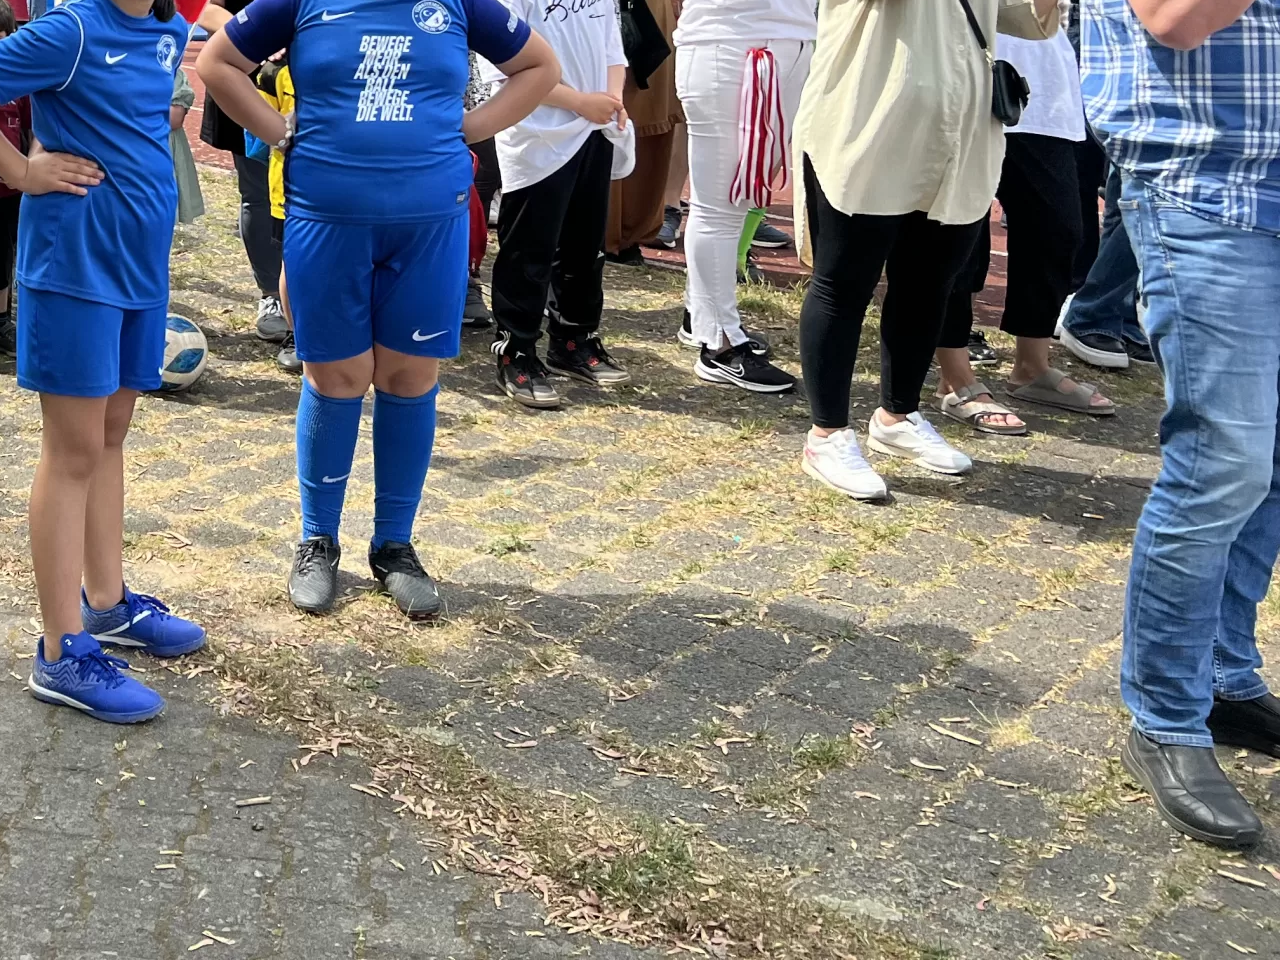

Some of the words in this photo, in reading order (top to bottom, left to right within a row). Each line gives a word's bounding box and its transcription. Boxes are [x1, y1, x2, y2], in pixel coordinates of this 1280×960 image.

[359, 35, 413, 52] BEWEGE
[363, 50, 402, 65] MEHR
[353, 63, 381, 79] ALS
[381, 63, 411, 80] DEN
[365, 78, 398, 92] BALL
[357, 90, 410, 106] BEWEGE
[355, 105, 378, 121] DIE
[380, 105, 414, 121] WELT.
